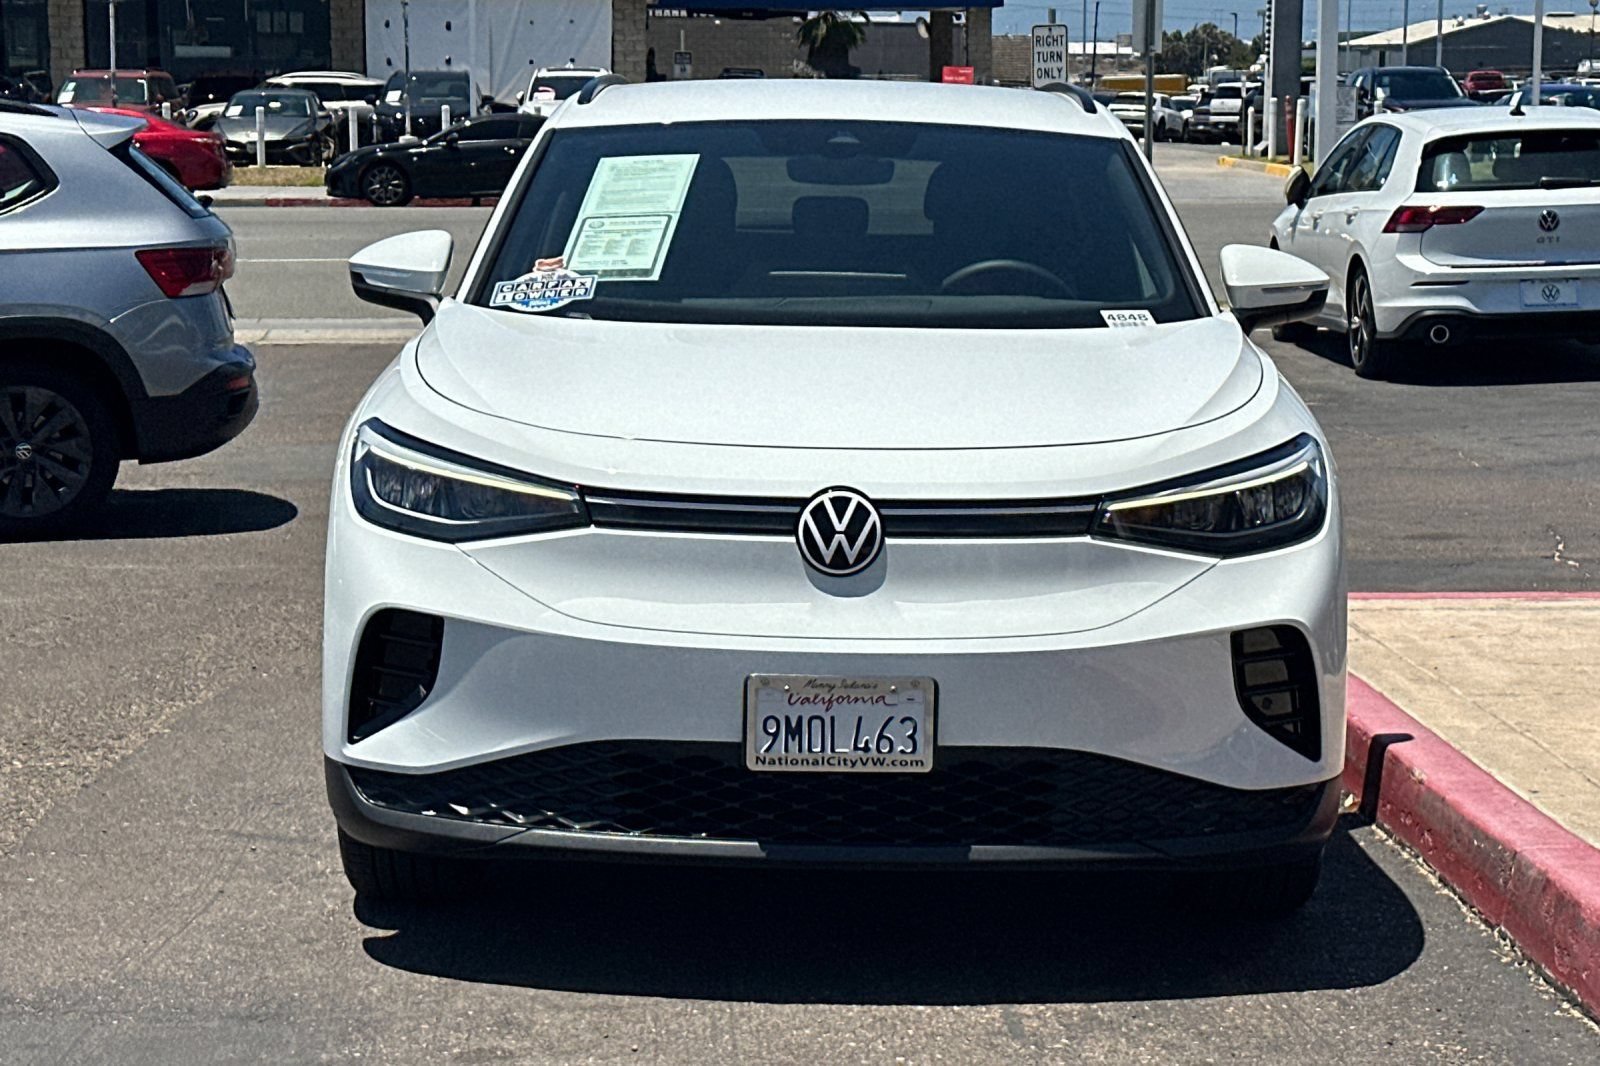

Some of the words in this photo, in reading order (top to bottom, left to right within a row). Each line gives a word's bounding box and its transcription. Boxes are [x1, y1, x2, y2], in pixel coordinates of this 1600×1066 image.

[1035, 34, 1065, 47] RIGHT
[1036, 51, 1063, 63] TURN
[1036, 66, 1063, 79] ONLY
[1536, 236, 1561, 244] GTI
[500, 280, 588, 293] CARFAX
[514, 288, 587, 301] OWNER
[787, 692, 898, 712] California
[760, 714, 918, 755] 9MOL463
[755, 755, 925, 768] NationalCityVW.com
